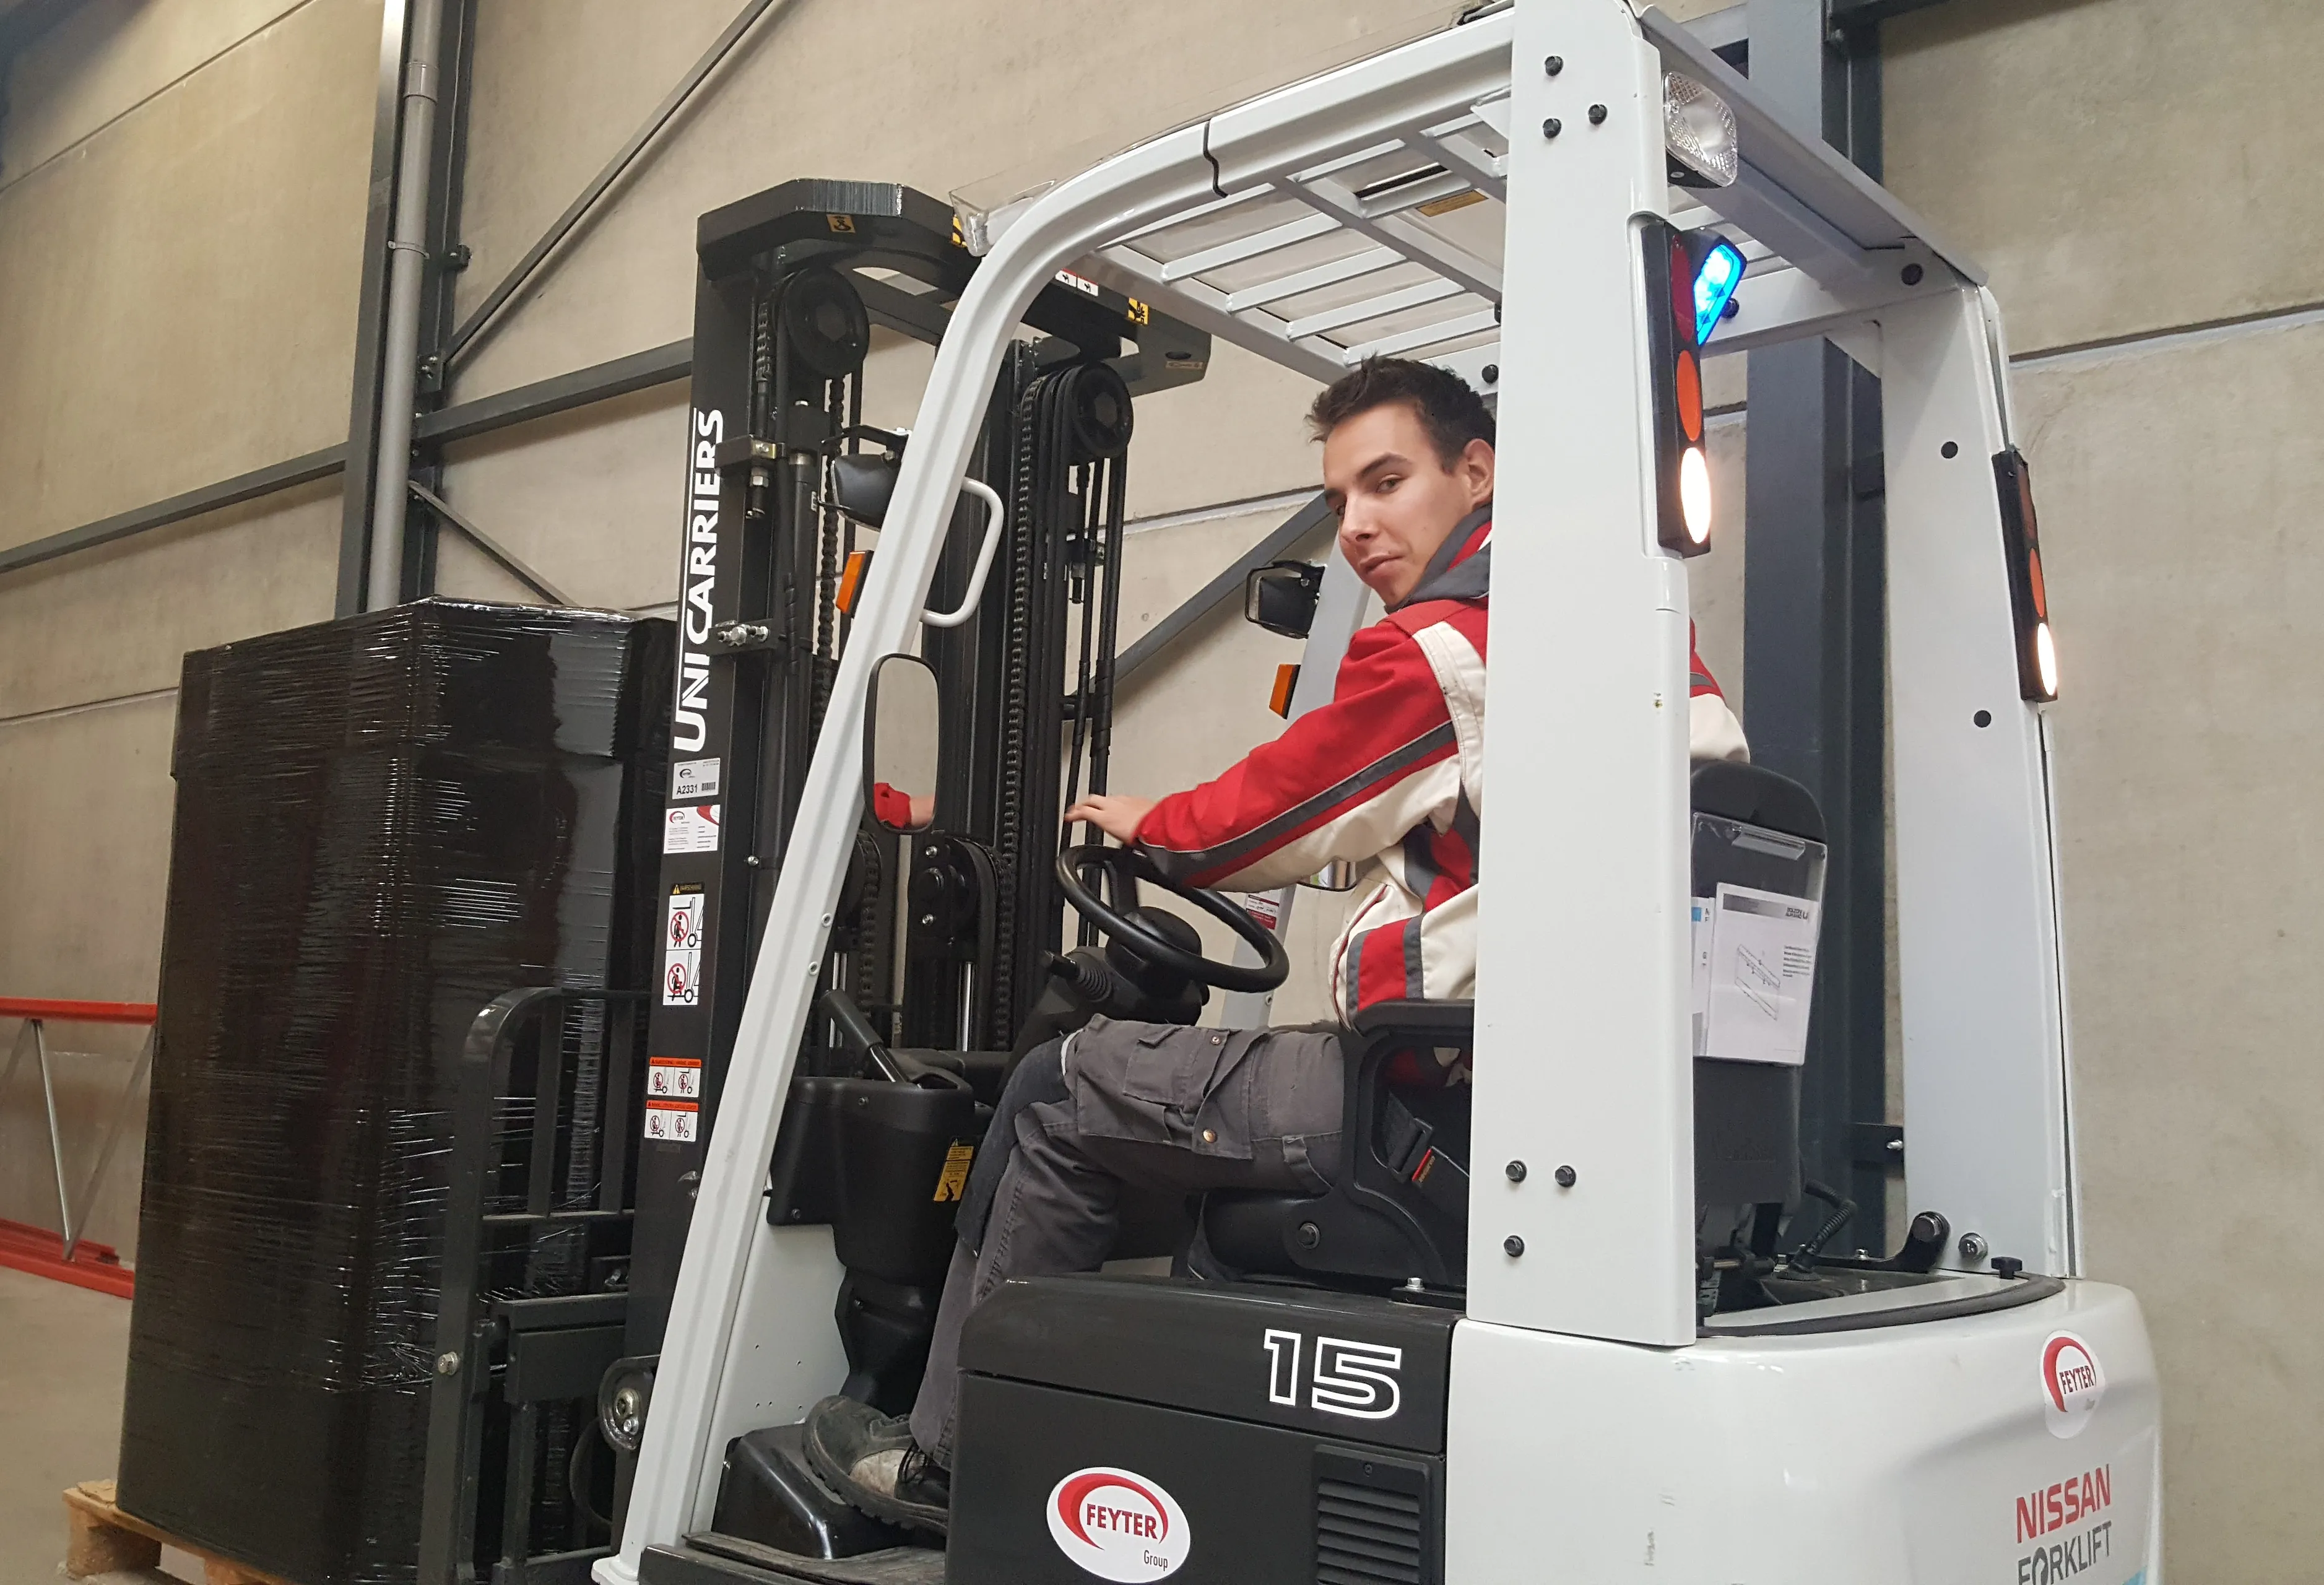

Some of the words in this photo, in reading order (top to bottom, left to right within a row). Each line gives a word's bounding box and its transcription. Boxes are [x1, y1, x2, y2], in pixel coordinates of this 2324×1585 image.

[674, 407, 724, 752] UNICARRIERS
[676, 784, 698, 795] A2331
[1264, 1329, 1402, 1419] 15
[2059, 1365, 2094, 1394] FEYTER
[1086, 1503, 1159, 1540] FEYTER
[2016, 1464, 2111, 1544] NISSAN
[1143, 1550, 1169, 1571] Group
[2018, 1520, 2112, 1585] FORKLIFT
